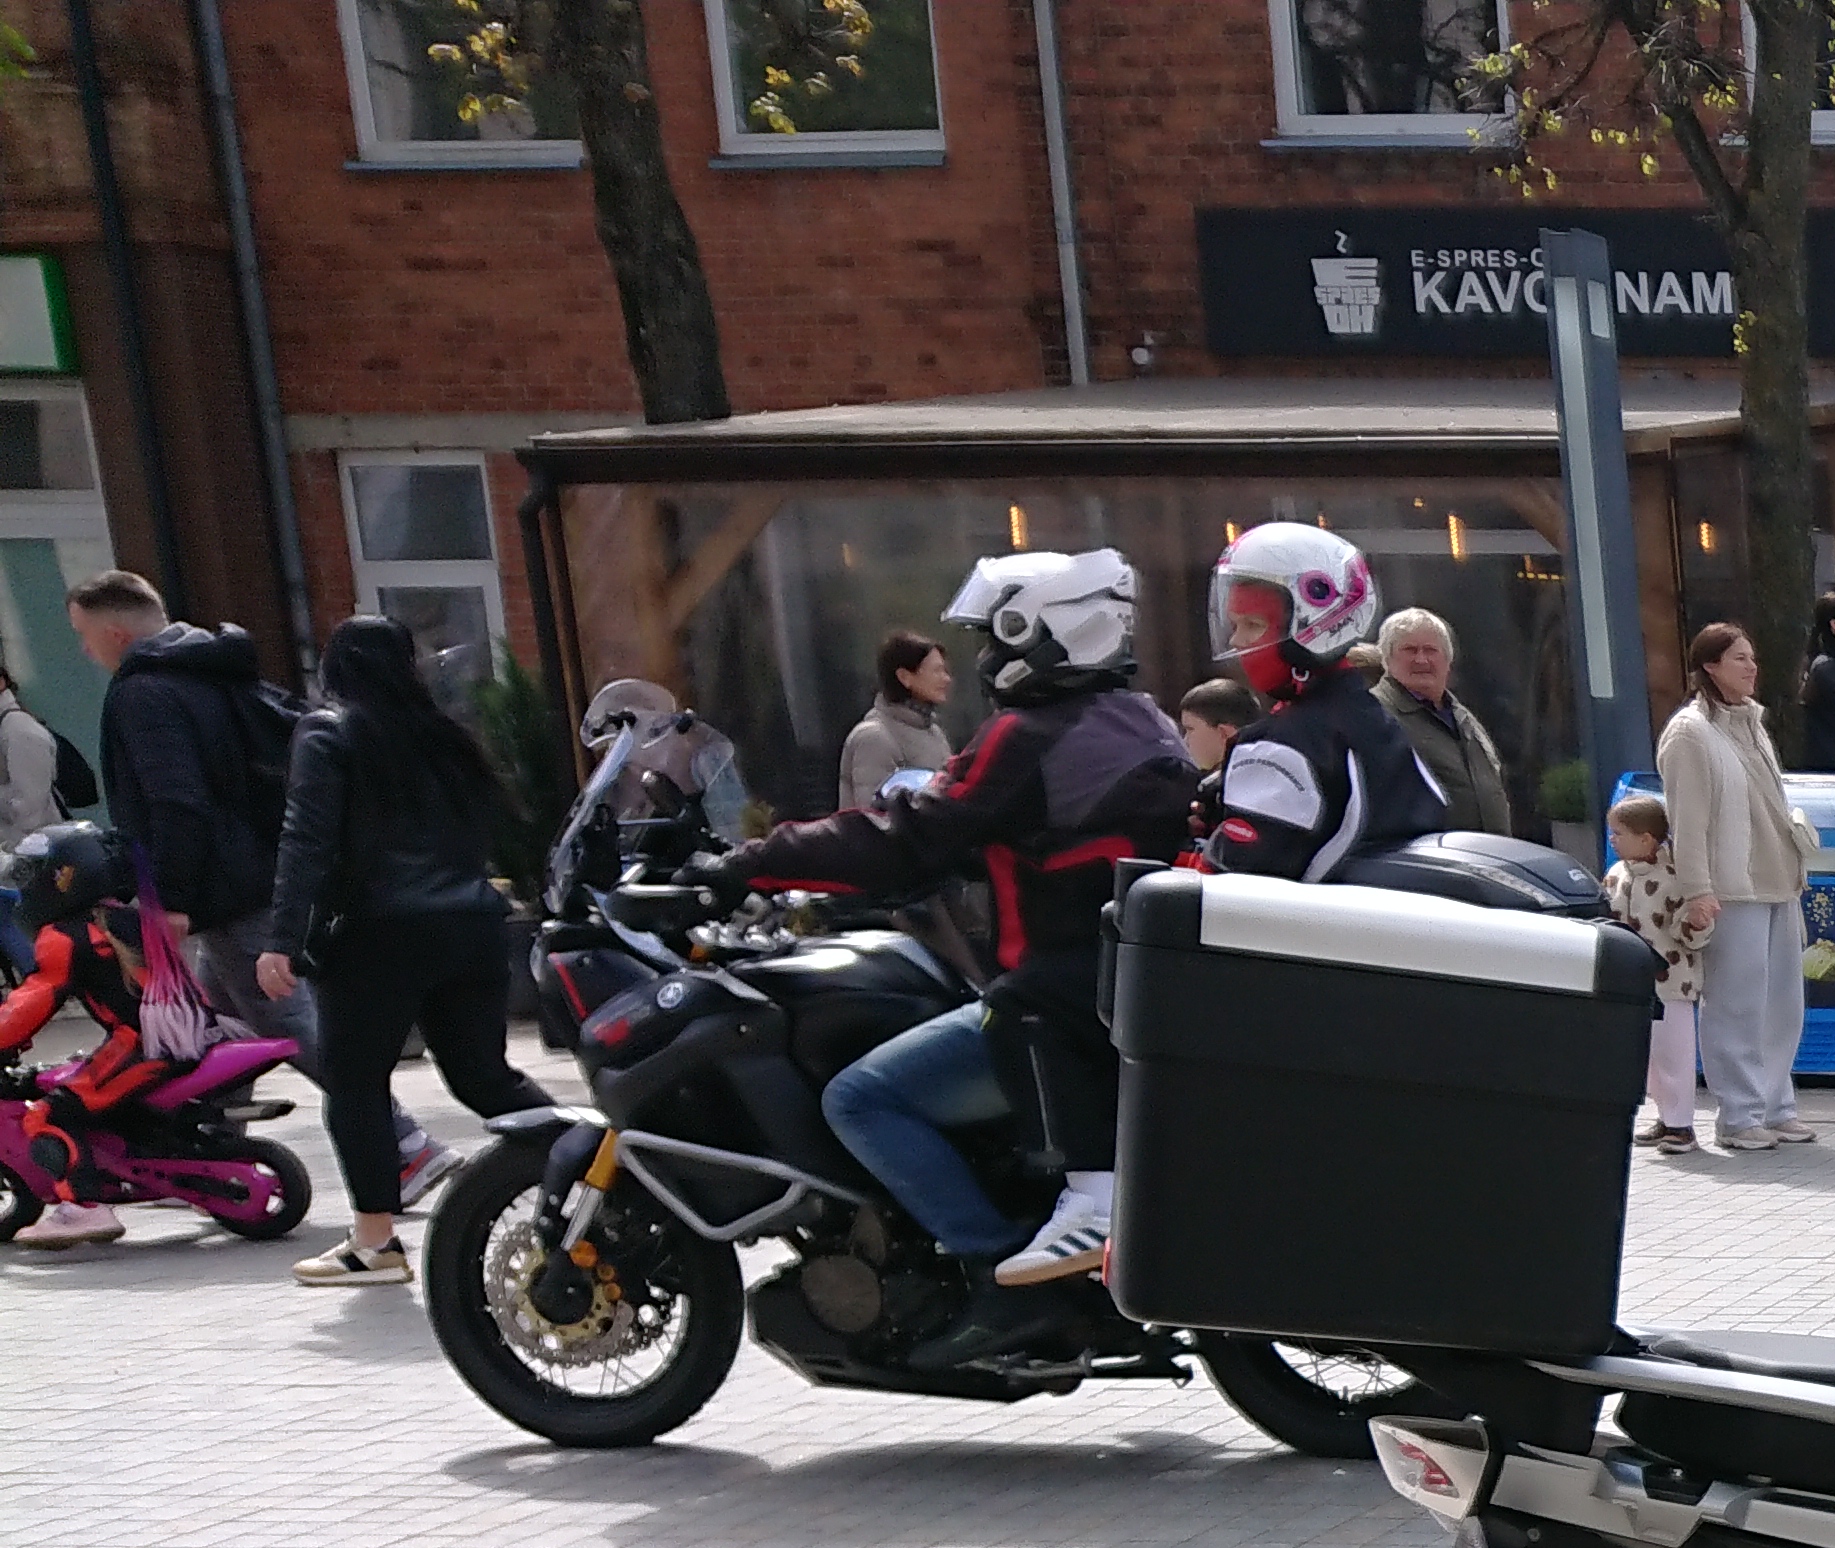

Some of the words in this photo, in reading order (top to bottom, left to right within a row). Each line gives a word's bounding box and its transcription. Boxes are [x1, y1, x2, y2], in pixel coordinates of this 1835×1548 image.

[1411, 249, 1545, 267] E-SPRES-O
[1413, 270, 1547, 314] KAVO
[1614, 271, 1734, 314] NAM
